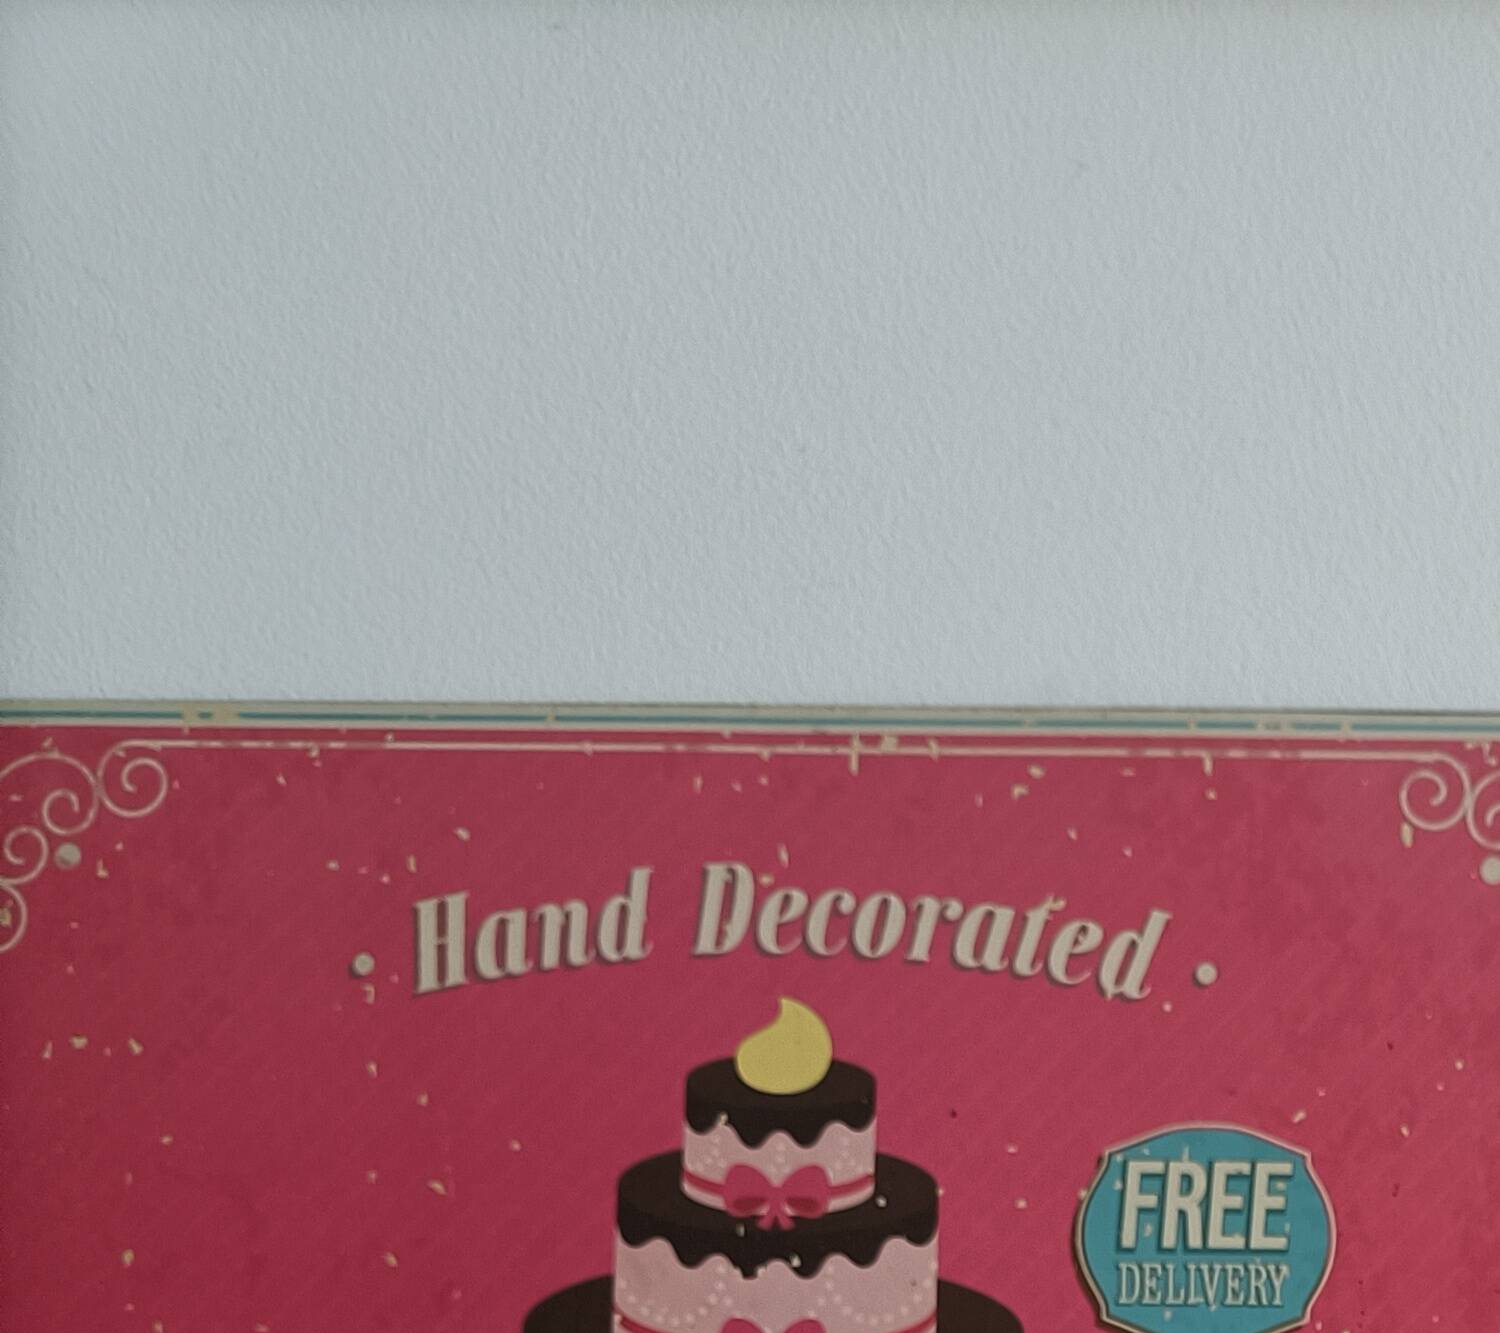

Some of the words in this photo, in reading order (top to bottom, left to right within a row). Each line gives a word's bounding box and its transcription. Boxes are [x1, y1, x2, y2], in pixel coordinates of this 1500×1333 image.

[411, 866, 654, 995] Hand
[691, 862, 1173, 999] Decorated
[1116, 1159, 1293, 1250] FREE
[1116, 1260, 1291, 1309] DELIVERY
